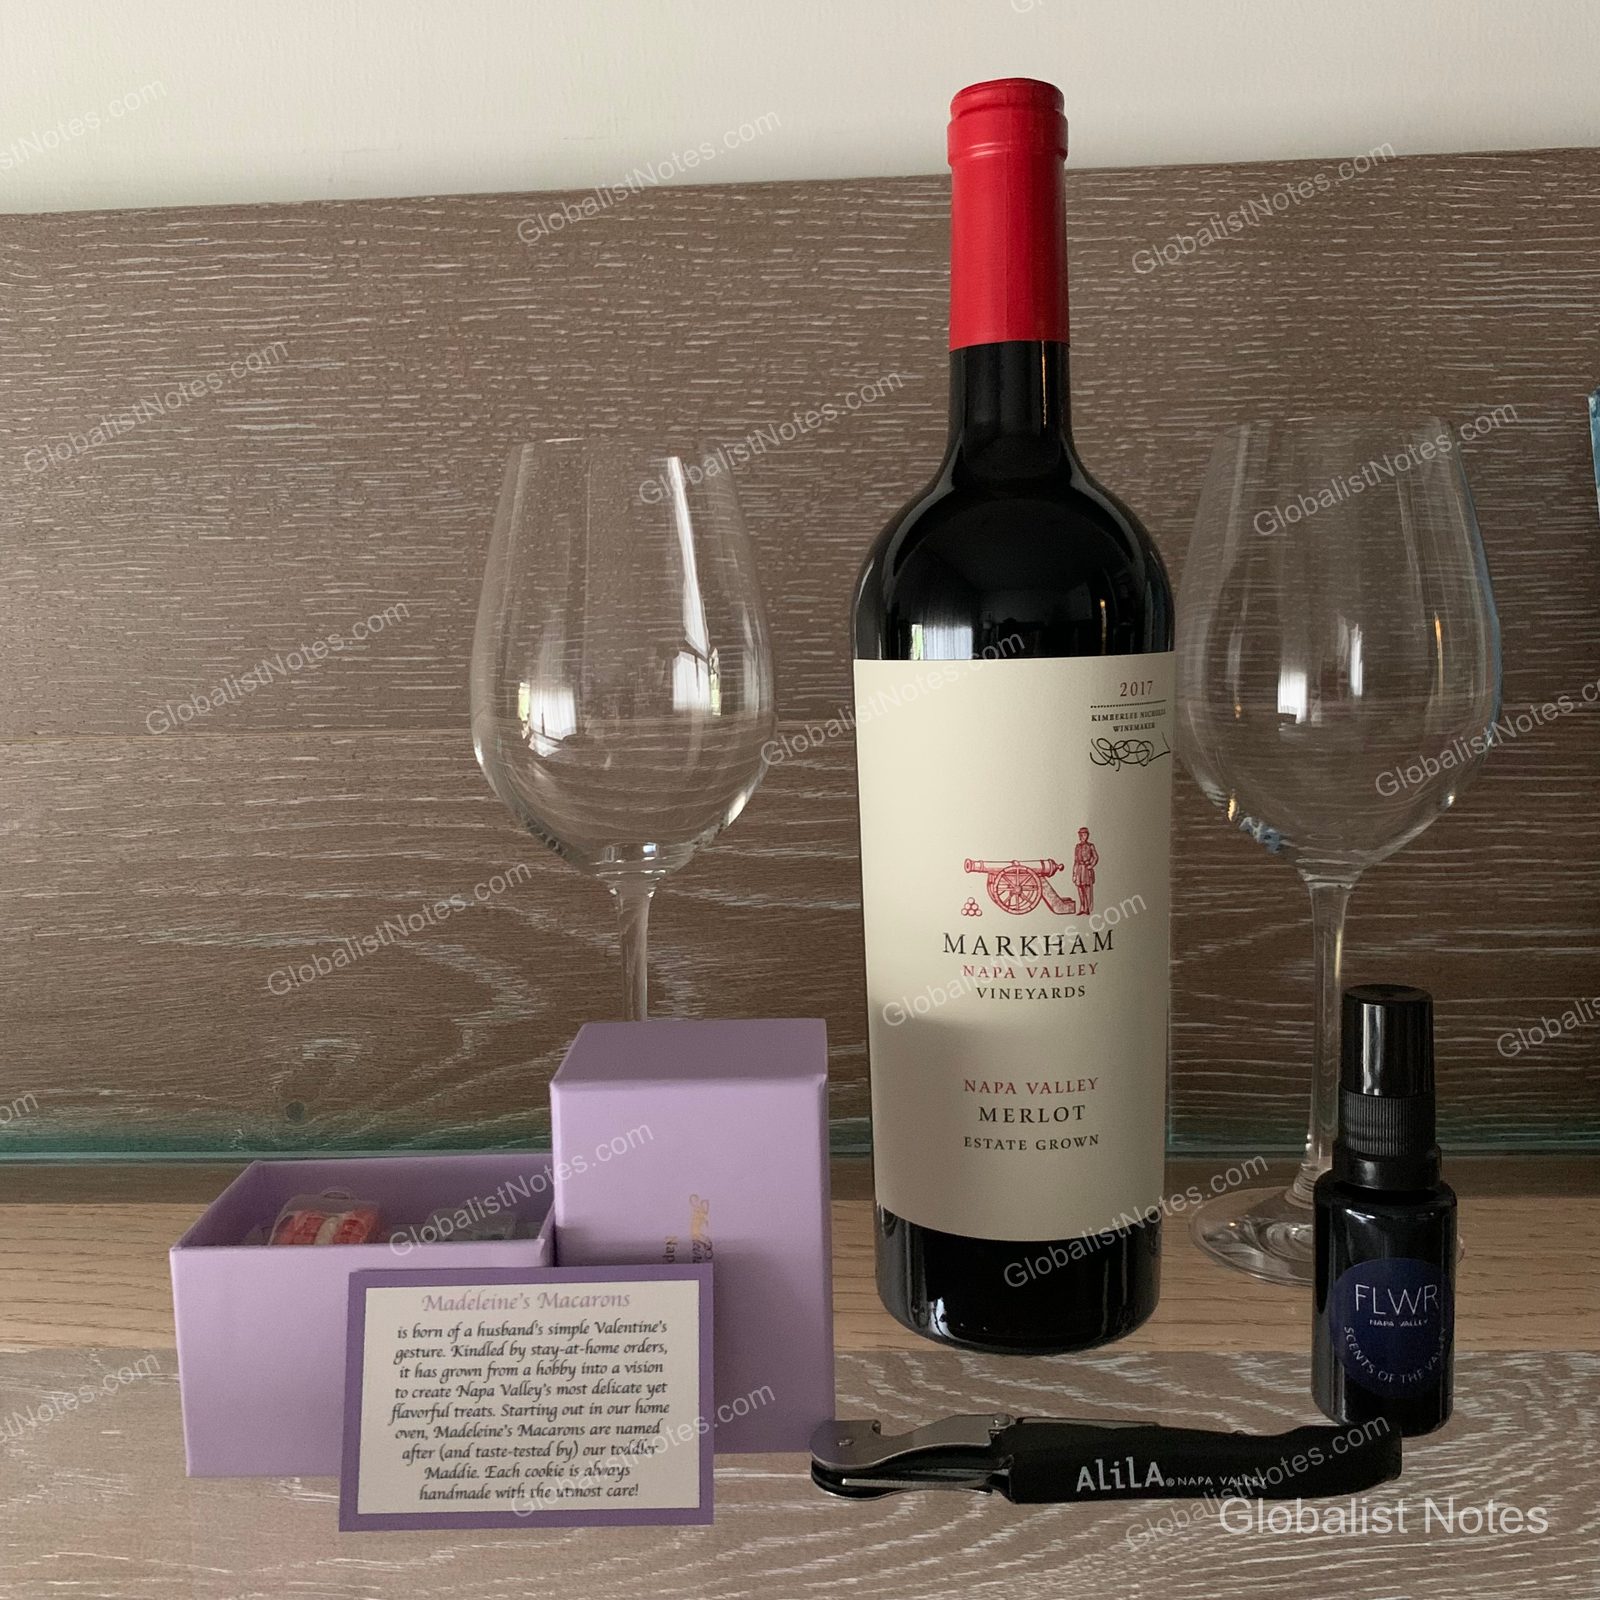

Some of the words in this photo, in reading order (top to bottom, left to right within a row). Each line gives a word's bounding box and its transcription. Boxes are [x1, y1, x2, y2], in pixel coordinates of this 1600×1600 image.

[1120, 681, 1153, 697] 2017
[1113, 722, 1155, 732] WINEMAKER
[942, 929, 1115, 956] MARKHAM
[963, 965, 1016, 979] NAPA
[1026, 962, 1099, 979] VALLEY
[976, 985, 1086, 1000] VINEYARDS
[964, 1079, 1017, 1094] NAPA
[1026, 1077, 1099, 1094] VALLEY
[978, 1104, 1085, 1123] MERLOT
[964, 1136, 1027, 1150] ESTATE
[1036, 1134, 1099, 1150] GROWN
[422, 1289, 530, 1311] Madeleine's
[537, 1292, 630, 1309] Macarons
[1355, 1284, 1439, 1315] FLWR
[397, 1326, 408, 1339] is
[412, 1322, 443, 1338] born
[447, 1321, 463, 1344] of
[463, 1327, 473, 1337] a
[477, 1320, 543, 1337] husband's
[548, 1319, 590, 1341] simple
[594, 1318, 668, 1335] Valentine's
[1369, 1319, 1394, 1327] NAPA
[393, 1347, 446, 1365] gesture.
[450, 1340, 508, 1358] Kindled
[509, 1340, 527, 1362] by
[531, 1338, 620, 1361] stay-at-home
[623, 1337, 668, 1355] orders,
[1343, 1326, 1376, 1374] SCENTS
[1377, 1370, 1396, 1383] OF
[1400, 1368, 1424, 1384] THE
[399, 1366, 411, 1378] it
[414, 1362, 437, 1378] has
[439, 1367, 482, 1384] grown
[483, 1360, 519, 1383] from
[522, 1366, 531, 1376] a
[536, 1360, 576, 1381] hobby
[581, 1362, 607, 1375] into
[611, 1364, 621, 1375] a
[624, 1361, 663, 1374] vision
[394, 1388, 408, 1398] to
[411, 1388, 452, 1398] create
[455, 1381, 495, 1404] Napa
[500, 1381, 551, 1402] Valley's
[556, 1385, 588, 1396] most
[591, 1379, 642, 1395] delicate
[646, 1382, 668, 1401] yet
[387, 1402, 453, 1426] flavorful
[454, 1406, 496, 1418] treats.
[500, 1404, 558, 1422] Starting
[561, 1405, 584, 1416] out
[589, 1403, 602, 1415] in
[606, 1405, 631, 1415] our
[634, 1398, 670, 1414] home
[394, 1429, 429, 1440] oven,
[433, 1422, 513, 1439] Madeleine's
[517, 1424, 585, 1437] Macarons
[589, 1425, 611, 1436] are
[615, 1418, 663, 1435] named
[402, 1443, 435, 1466] after
[439, 1442, 475, 1462] (and
[475, 1440, 555, 1457] taste-tested
[556, 1440, 579, 1463] by)
[582, 1446, 606, 1456] our
[610, 1439, 659, 1456] toddler
[424, 1462, 480, 1480] Maddie.
[484, 1462, 521, 1479] Each
[524, 1461, 565, 1478] cookie
[569, 1464, 580, 1478] is
[584, 1460, 631, 1482] always
[1178, 1476, 1213, 1487] NAPA
[1219, 1475, 1267, 1488] VALLEY
[419, 1483, 491, 1500] handmade
[495, 1482, 525, 1499] with
[530, 1482, 551, 1499] the
[556, 1486, 602, 1498] utmost
[606, 1483, 639, 1497] care!
